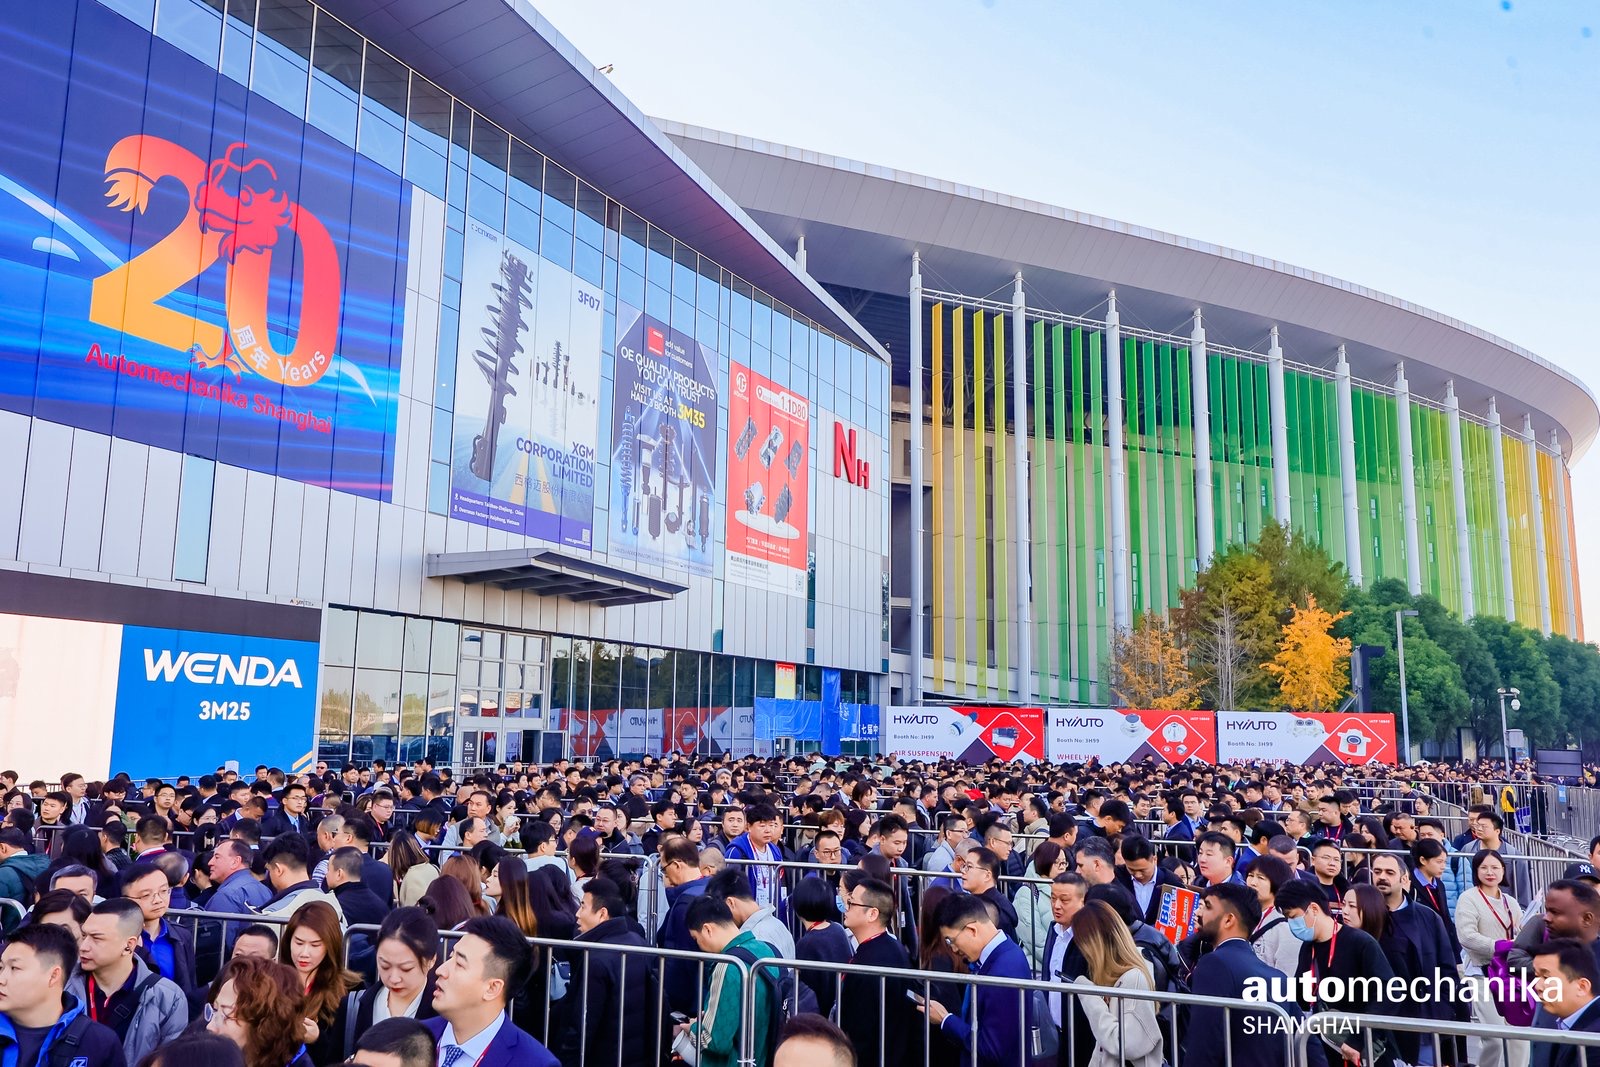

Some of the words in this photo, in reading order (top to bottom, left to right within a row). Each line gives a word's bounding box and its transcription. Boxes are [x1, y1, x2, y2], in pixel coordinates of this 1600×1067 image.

[89, 133, 341, 387] 20
[577, 289, 601, 312] 3F07
[233, 324, 270, 371] 周年
[277, 349, 326, 382] Years
[620, 346, 634, 362] OE
[636, 352, 672, 377] QUALITY
[674, 371, 715, 400] PRODUCTS
[85, 343, 248, 410] Automechanika
[252, 394, 333, 434] Shanghai
[633, 380, 652, 396] VISIT
[653, 390, 662, 402] US
[664, 396, 674, 406] AT
[636, 365, 656, 382] YOU
[657, 375, 675, 392] CAN
[676, 384, 702, 404] TRUST
[630, 390, 648, 406] HALL
[654, 400, 677, 418] BOOTH
[677, 403, 706, 429] 3M35
[780, 395, 806, 420] 1.1D80
[516, 436, 594, 474] CORPORATION
[572, 441, 594, 460] XGM
[552, 465, 593, 488] LIMITED
[143, 648, 303, 688] WENDA
[198, 700, 251, 721] 3M25
[1160, 892, 1172, 925] BIG
